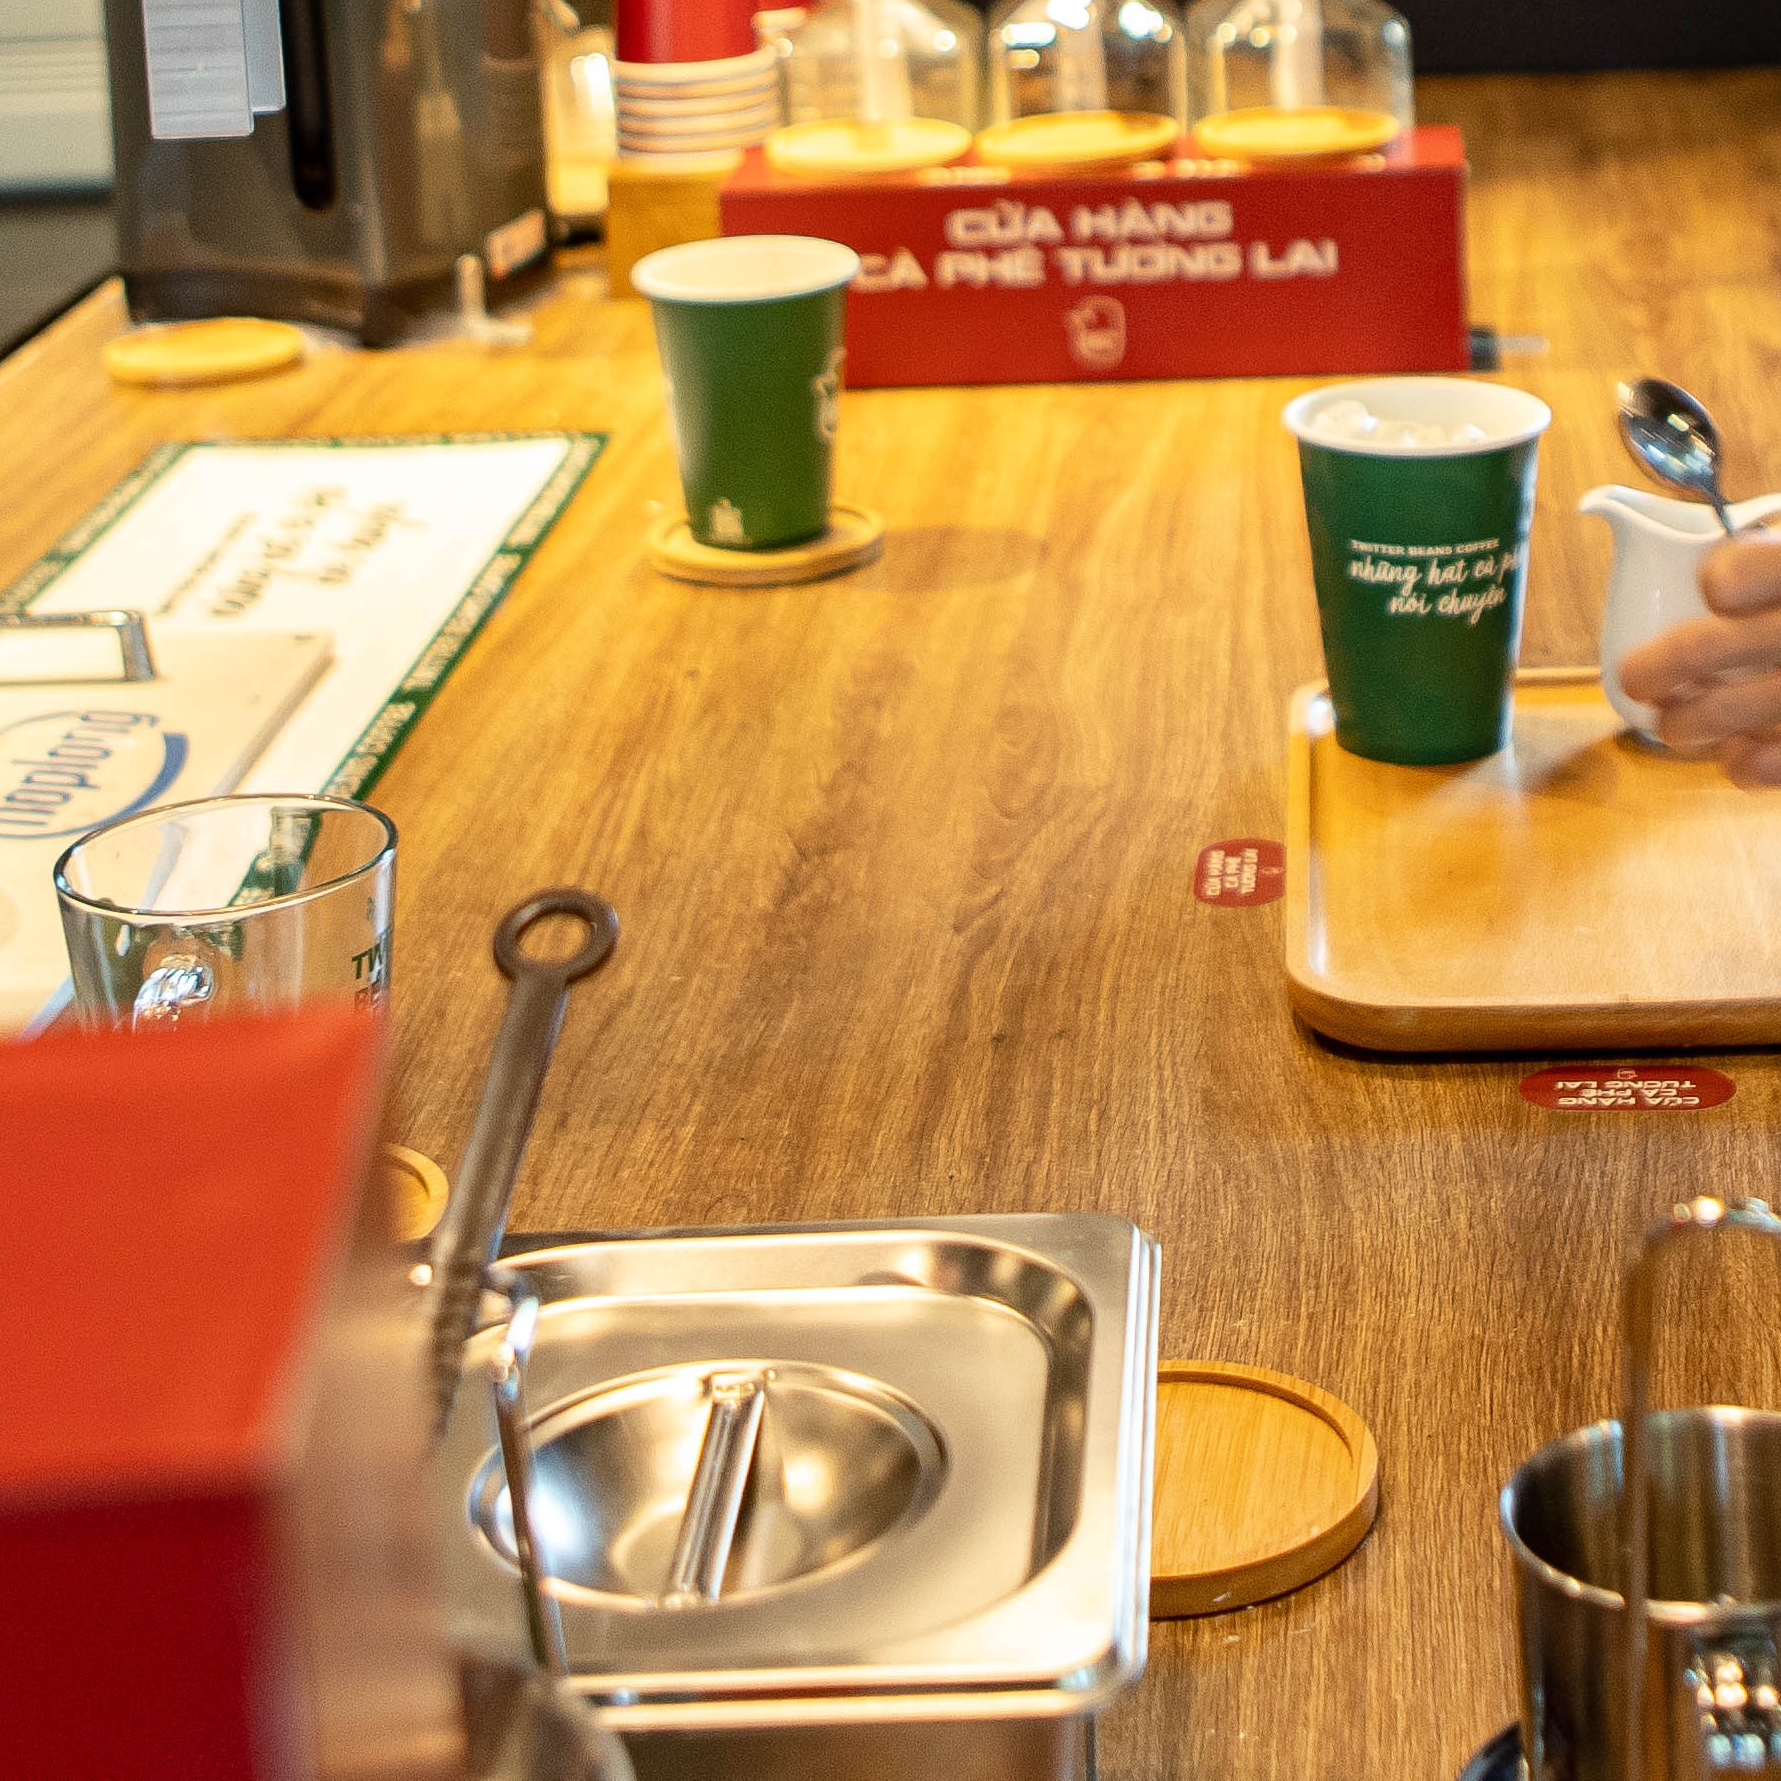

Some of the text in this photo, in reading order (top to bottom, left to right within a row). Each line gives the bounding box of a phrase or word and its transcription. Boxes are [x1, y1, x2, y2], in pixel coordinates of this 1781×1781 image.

[1247, 236, 1340, 280] LAI
[1349, 538, 1500, 557] TWITTER BEANS COFFEE
